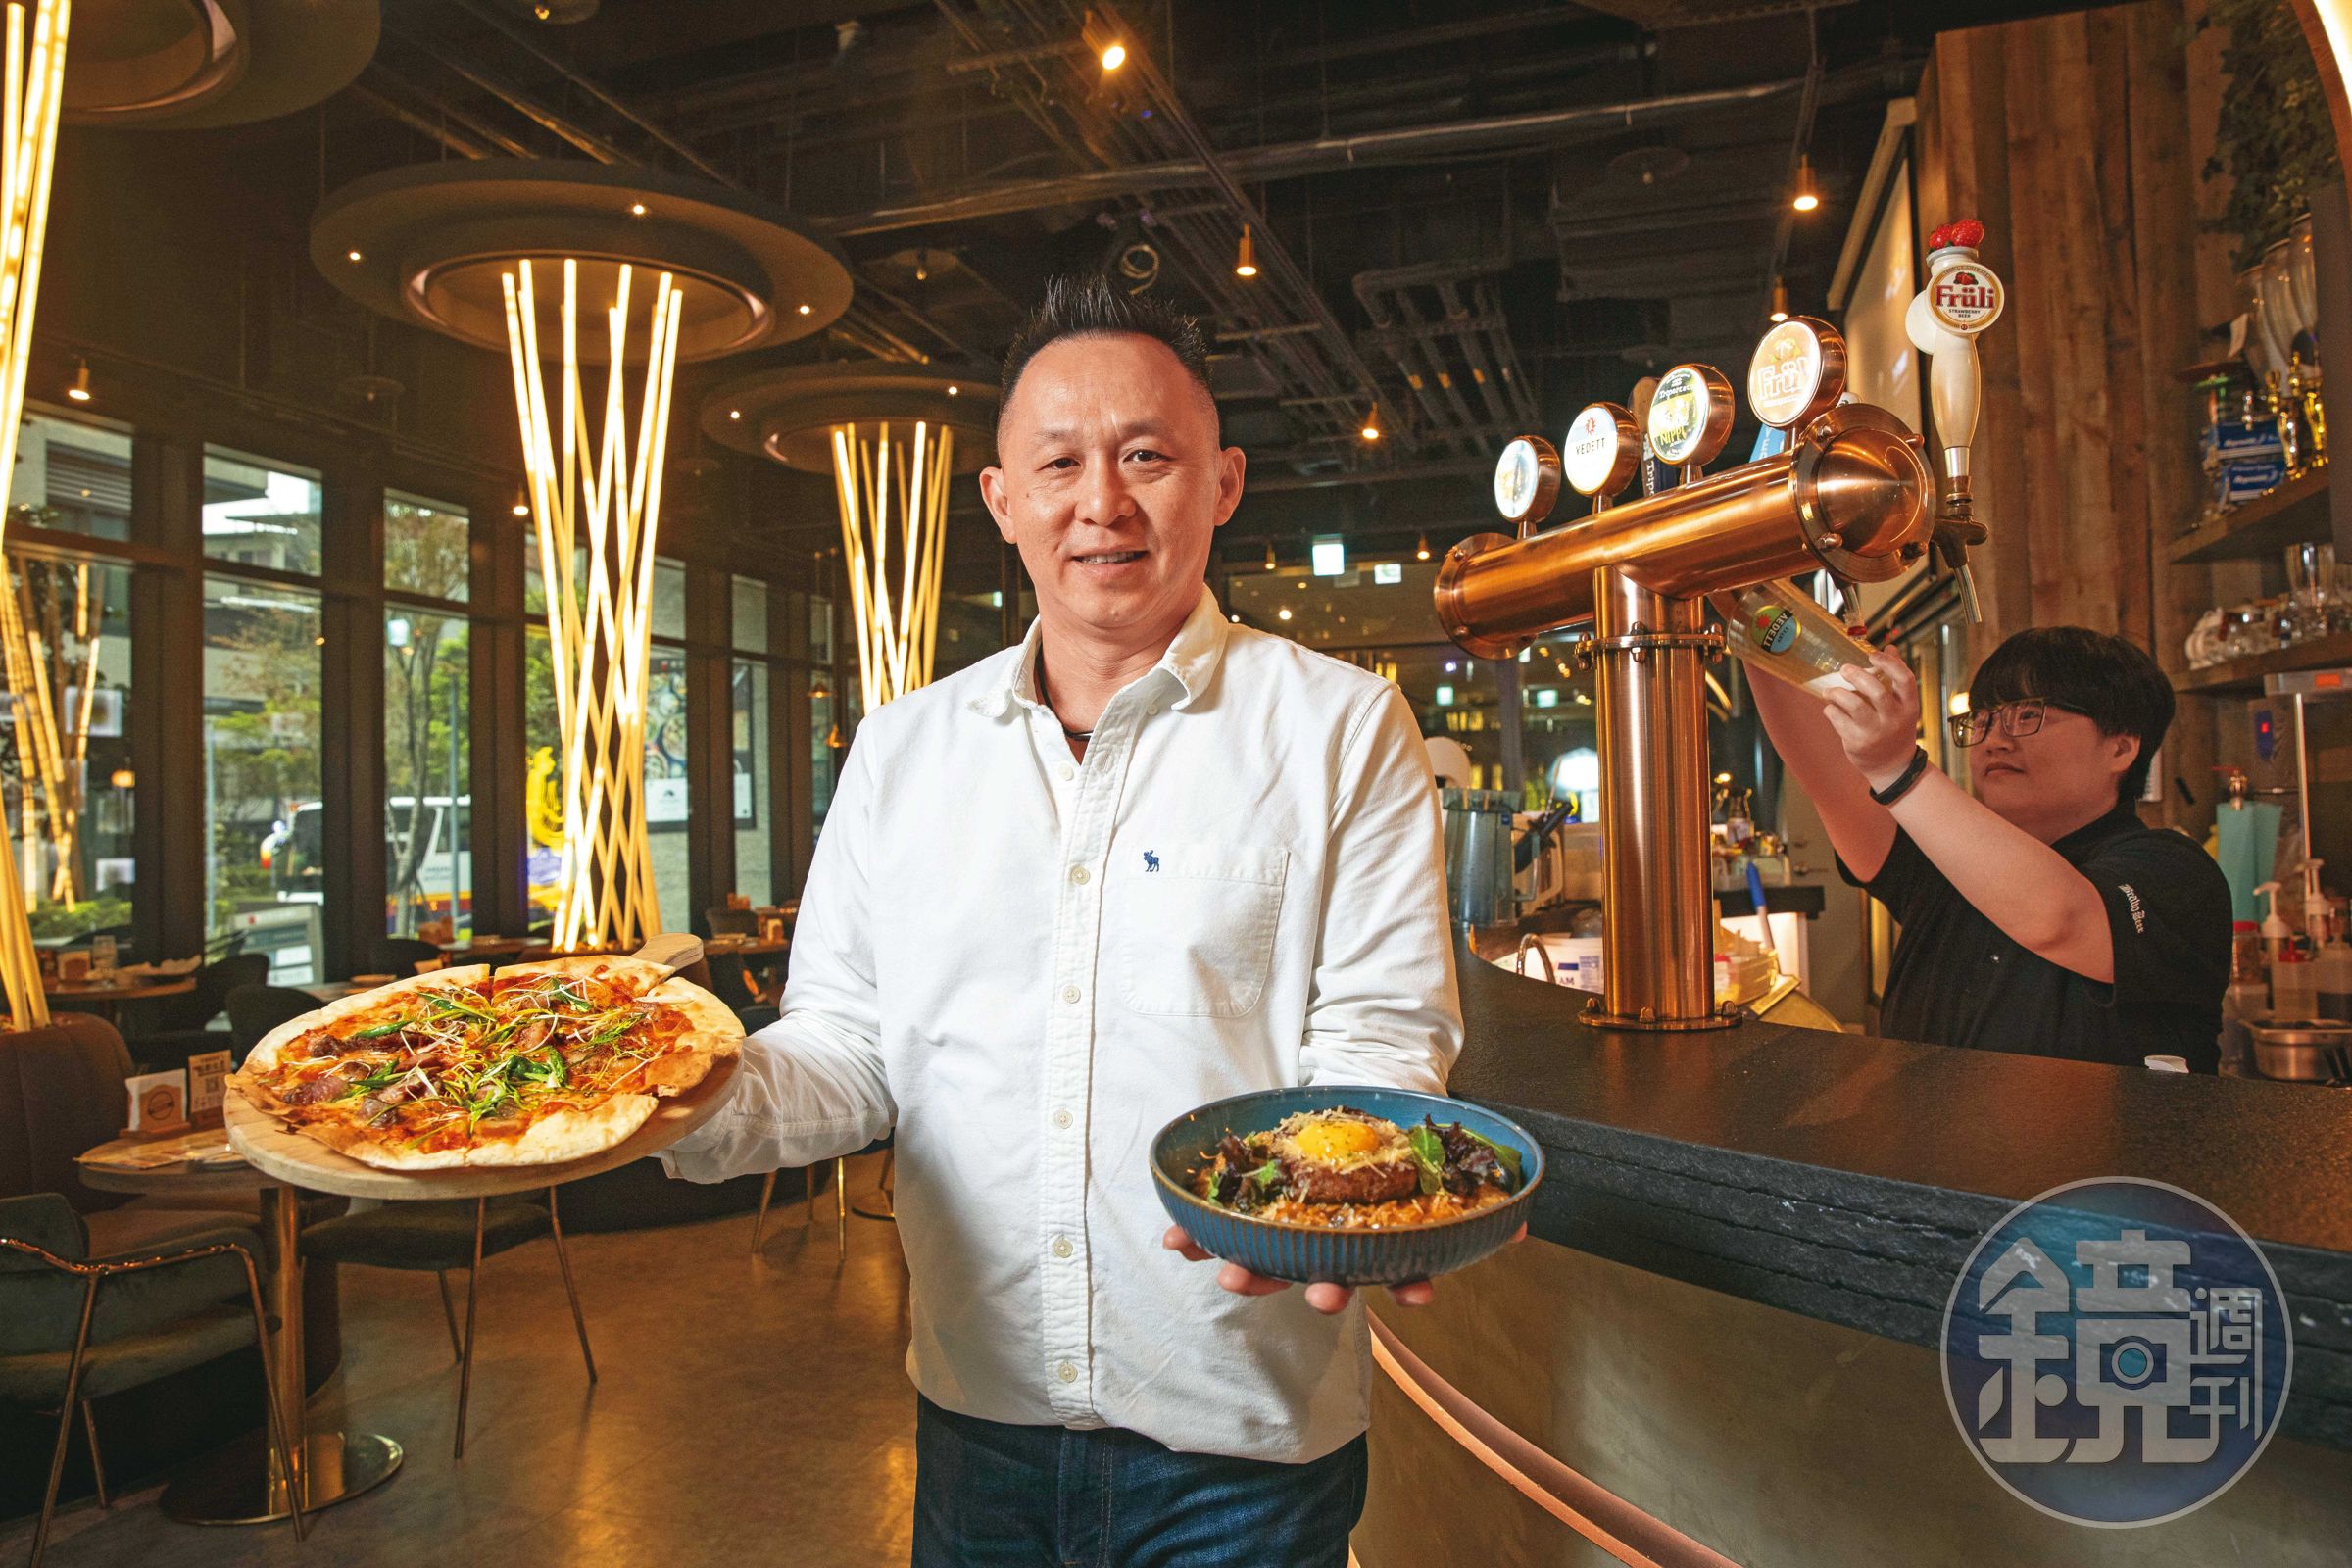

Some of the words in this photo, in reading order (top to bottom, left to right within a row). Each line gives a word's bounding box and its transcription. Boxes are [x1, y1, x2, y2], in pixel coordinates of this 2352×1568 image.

[1936, 284, 1994, 309] Früli
[1576, 437, 1605, 455] VEDETT
[2118, 883, 2140, 912] Bravo
[2132, 909, 2145, 934] Beer
